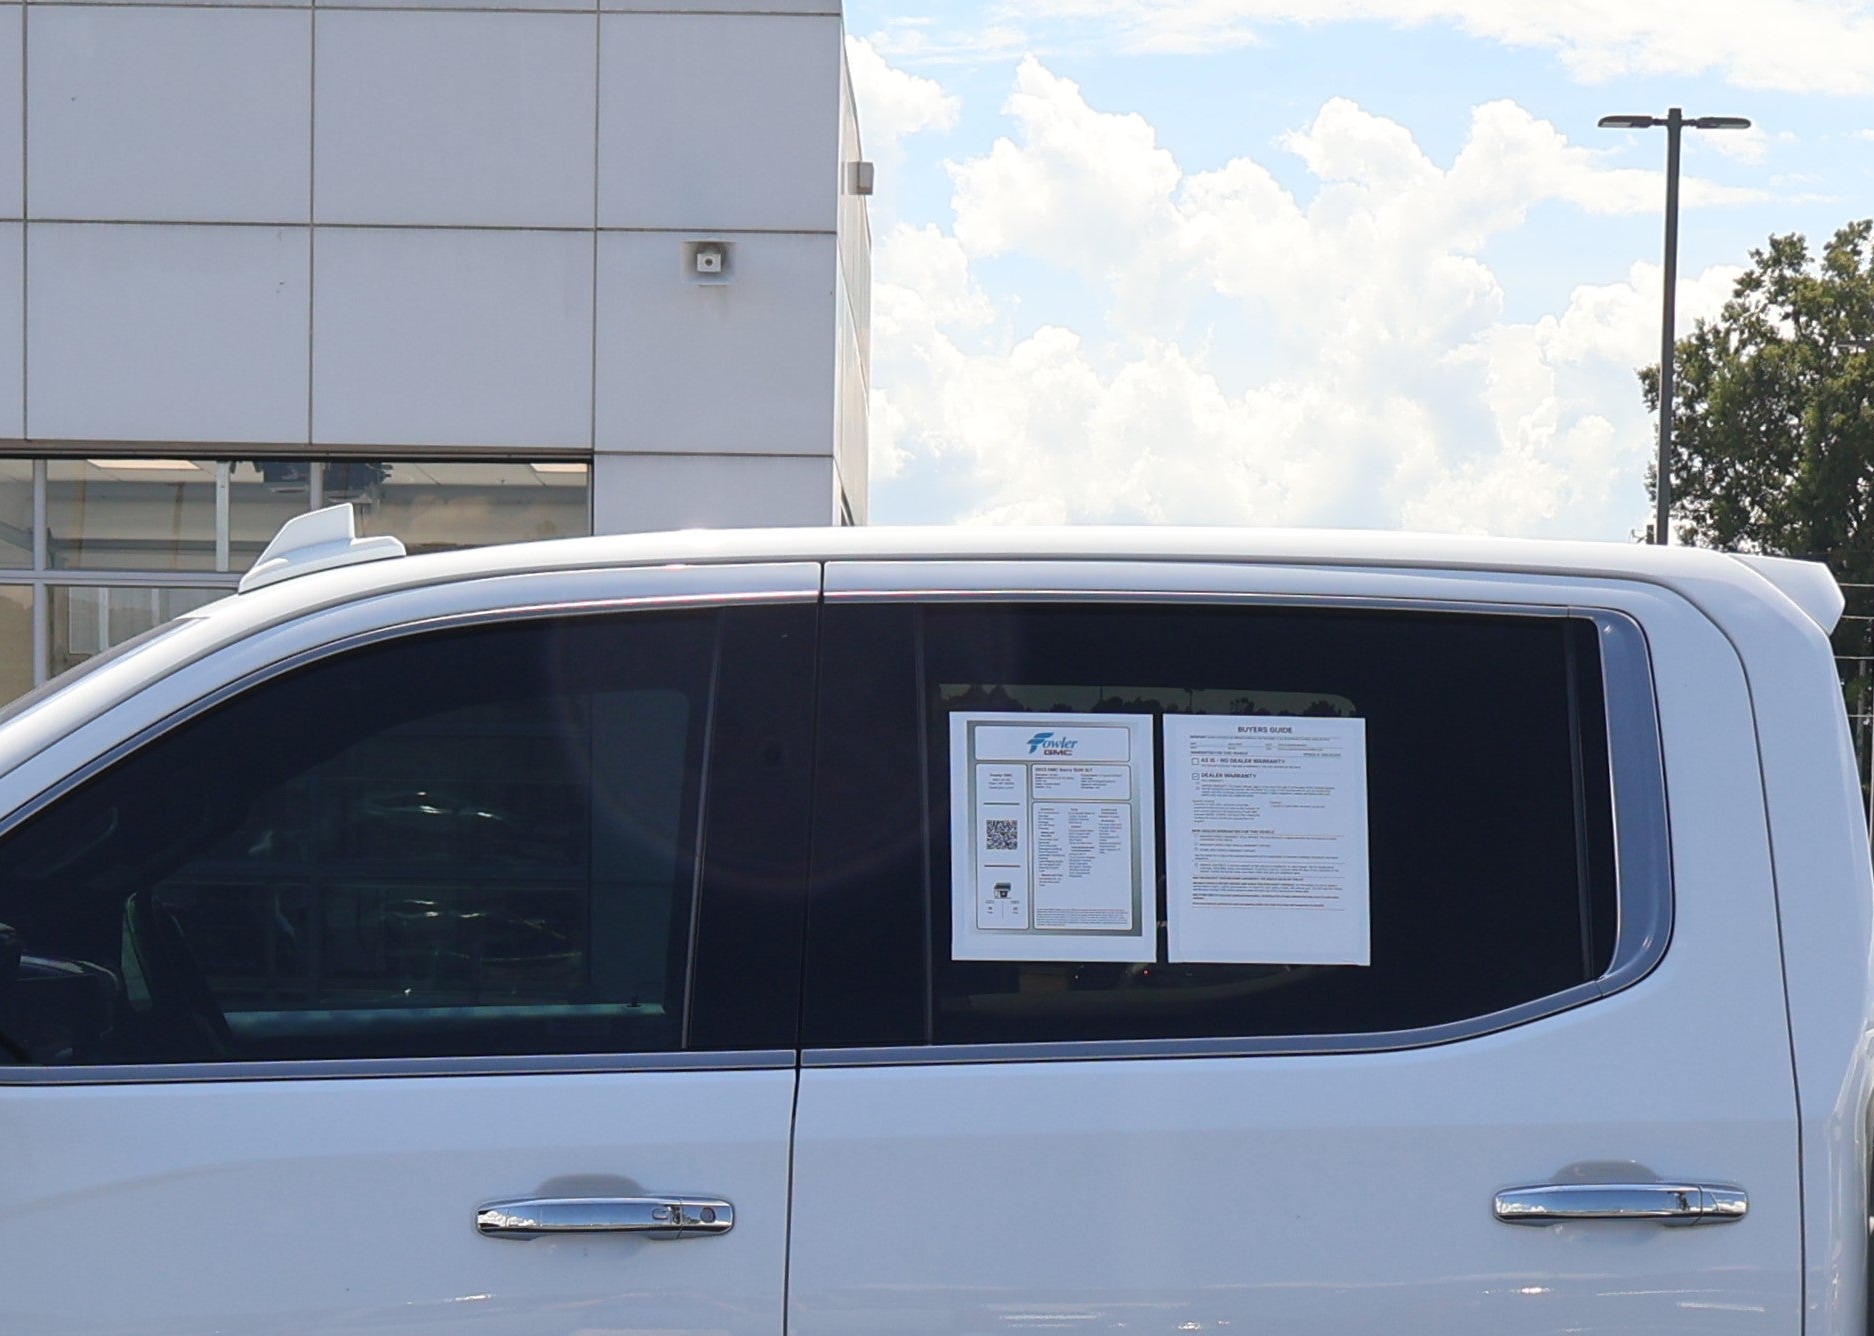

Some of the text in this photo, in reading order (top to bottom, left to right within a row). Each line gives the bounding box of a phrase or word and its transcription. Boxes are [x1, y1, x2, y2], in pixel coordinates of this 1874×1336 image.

[1237, 726, 1293, 734] BUYERS GUIDE
[1026, 731, 1078, 755] Fowler
